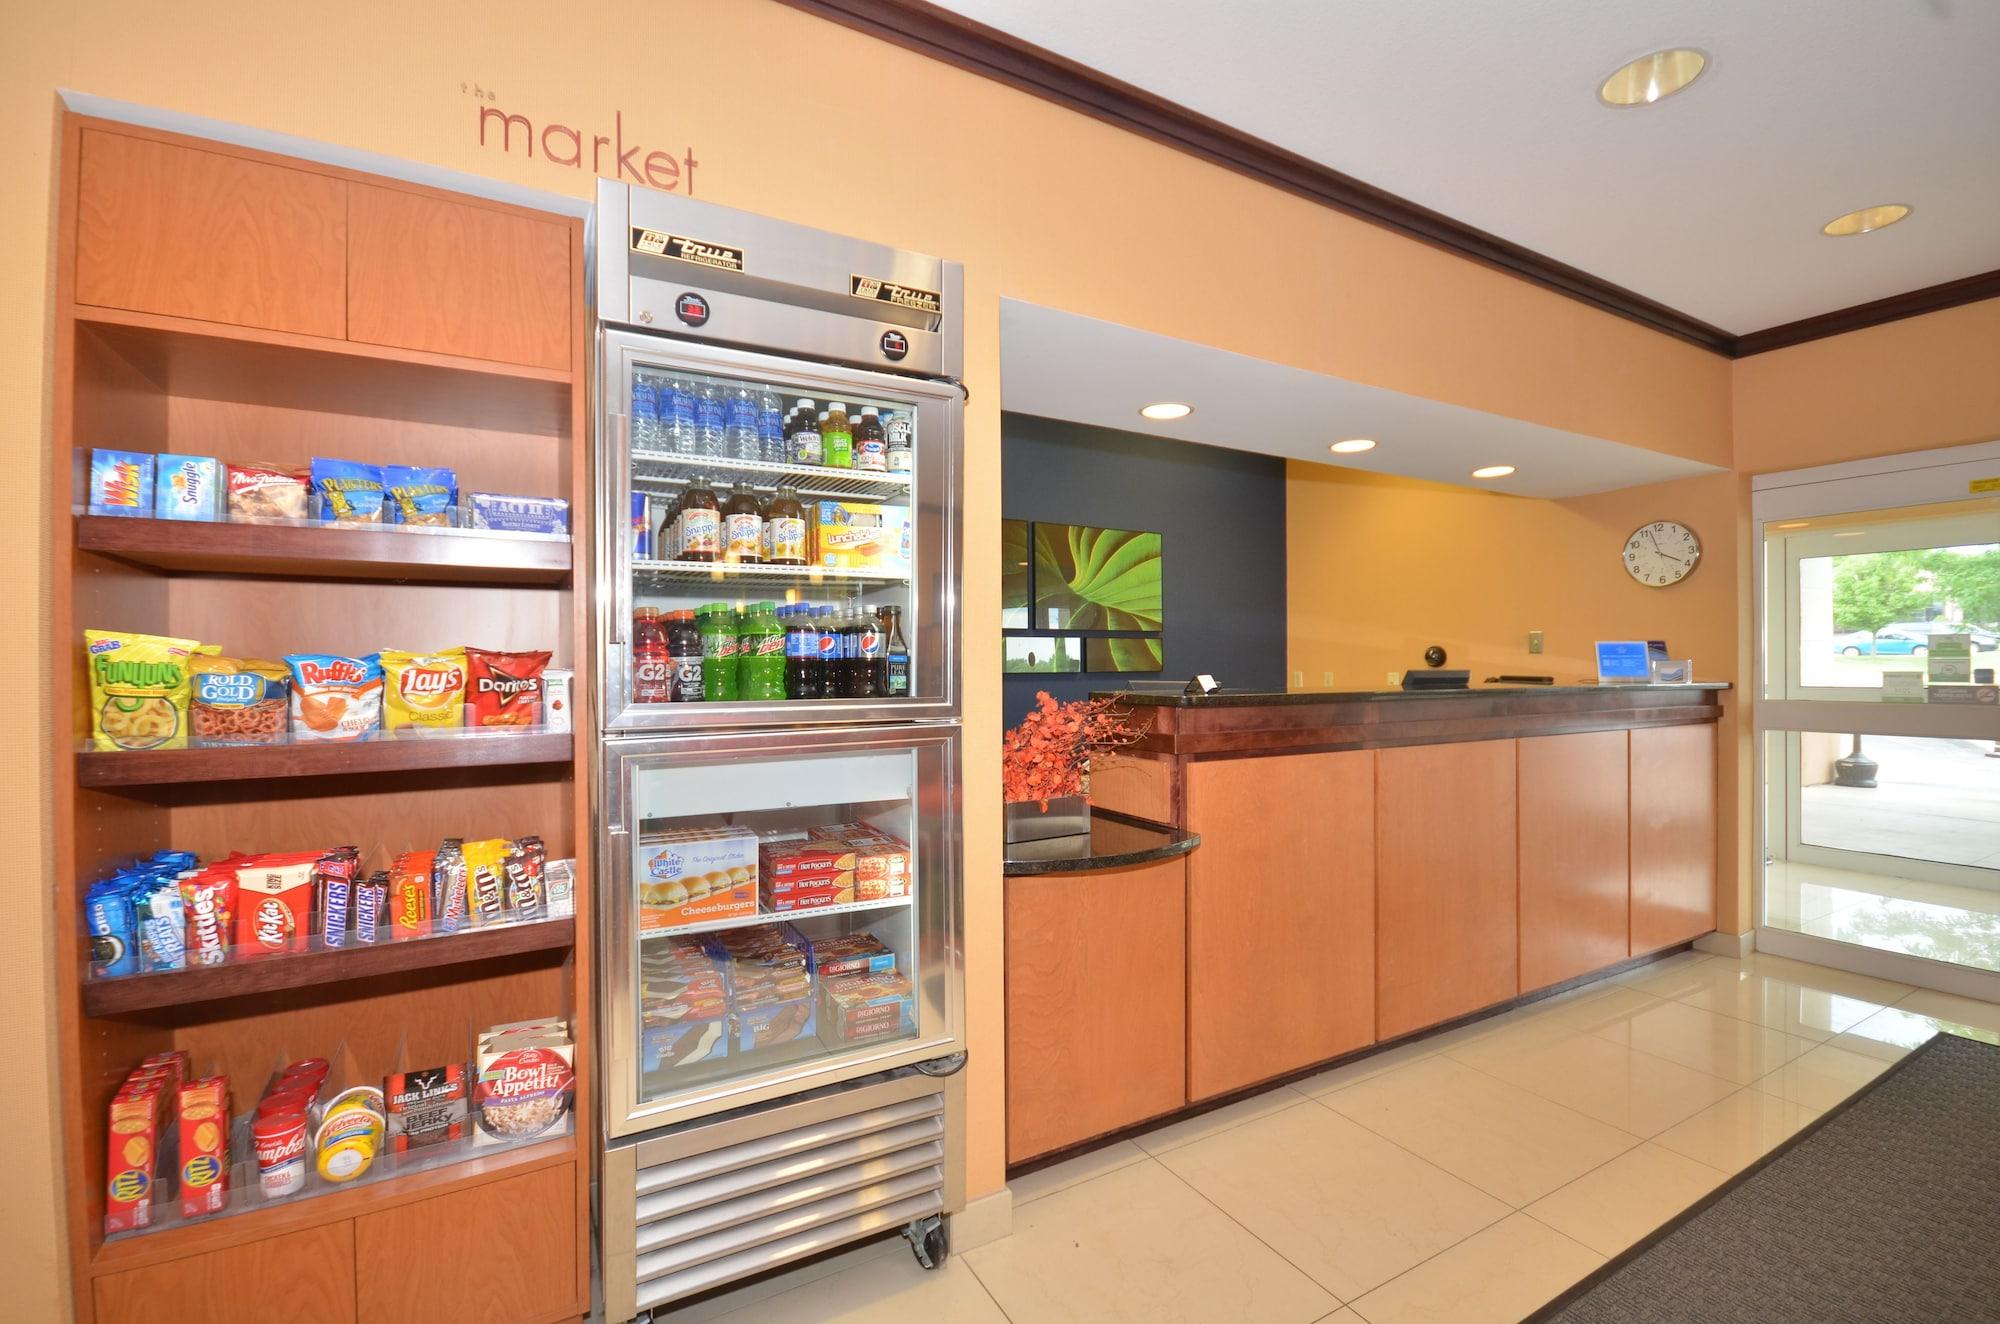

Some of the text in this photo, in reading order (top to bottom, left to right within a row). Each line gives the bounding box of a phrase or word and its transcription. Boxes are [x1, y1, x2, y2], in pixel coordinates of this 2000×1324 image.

[460, 81, 496, 101] the
[479, 105, 699, 196] market
[681, 253, 737, 269] REFRIGERATOR
[104, 460, 140, 507] Wisk
[182, 462, 200, 505] Snuggle
[322, 477, 383, 492] PLANTERS
[498, 503, 543, 515] ACT II
[1640, 530, 1649, 538] 11
[1653, 523, 1665, 532] 12
[1672, 525, 1676, 533] 1
[1683, 532, 1690, 541] 2
[1630, 540, 1640, 549] 10
[1688, 545, 1695, 554] 3
[1629, 553, 1636, 561] 9
[1684, 559, 1691, 567] 4
[1633, 565, 1640, 574] 8
[1675, 570, 1682, 579] 5
[1644, 573, 1650, 582] 7
[1659, 575, 1666, 584] 6
[300, 660, 366, 685] Ruffles
[639, 663, 665, 681] G2
[679, 664, 702, 682] G2
[208, 674, 253, 687] ROLD
[403, 668, 461, 695] Lay's
[479, 677, 538, 693] Doritos
[202, 685, 255, 700] GOLD
[408, 711, 453, 722] Classic
[654, 858, 680, 868] White
[800, 862, 811, 870] HOT
[651, 867, 683, 876] Castle
[274, 873, 282, 890] SIZE
[799, 880, 809, 888] HOT
[400, 884, 417, 930] Reese's
[800, 897, 810, 905] HOT
[326, 882, 348, 946] SNICKERS
[358, 886, 374, 941] SNICKERS
[681, 900, 755, 916] Cheeseburgers
[194, 885, 225, 965] Skittles
[829, 961, 861, 973] DIGIORNO
[857, 1005, 890, 1018] DIGIORNO
[856, 1021, 889, 1034] DIGIORNO
[504, 1063, 547, 1082] Bowl
[393, 1091, 420, 1105] JACK
[406, 1107, 448, 1122] BEEF
[402, 1112, 454, 1131] JERKY
